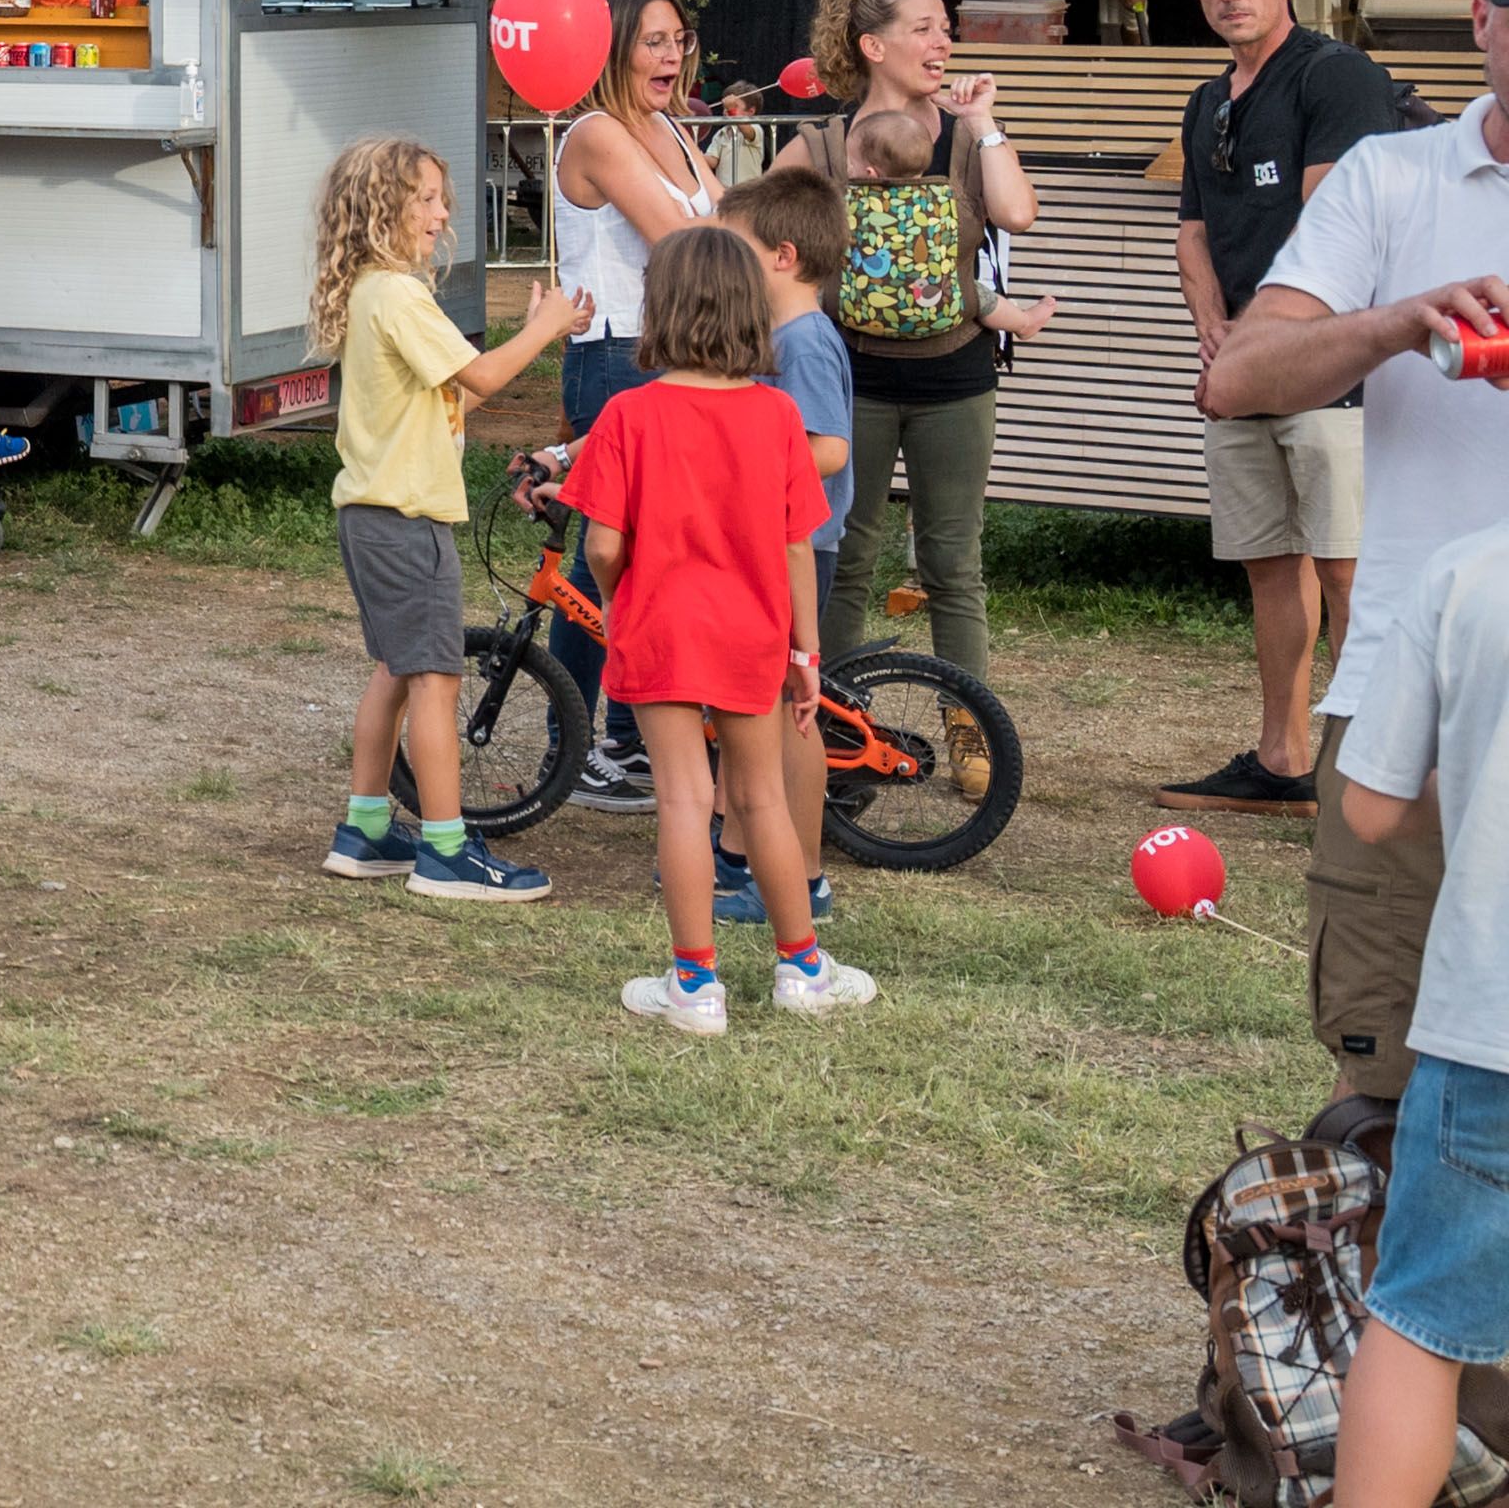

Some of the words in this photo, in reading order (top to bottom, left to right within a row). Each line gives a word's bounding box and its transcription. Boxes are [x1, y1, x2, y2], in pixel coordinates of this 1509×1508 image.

[1253, 160, 1280, 187] DC
[304, 373, 326, 404] BDC
[1138, 826, 1190, 856] TOT
